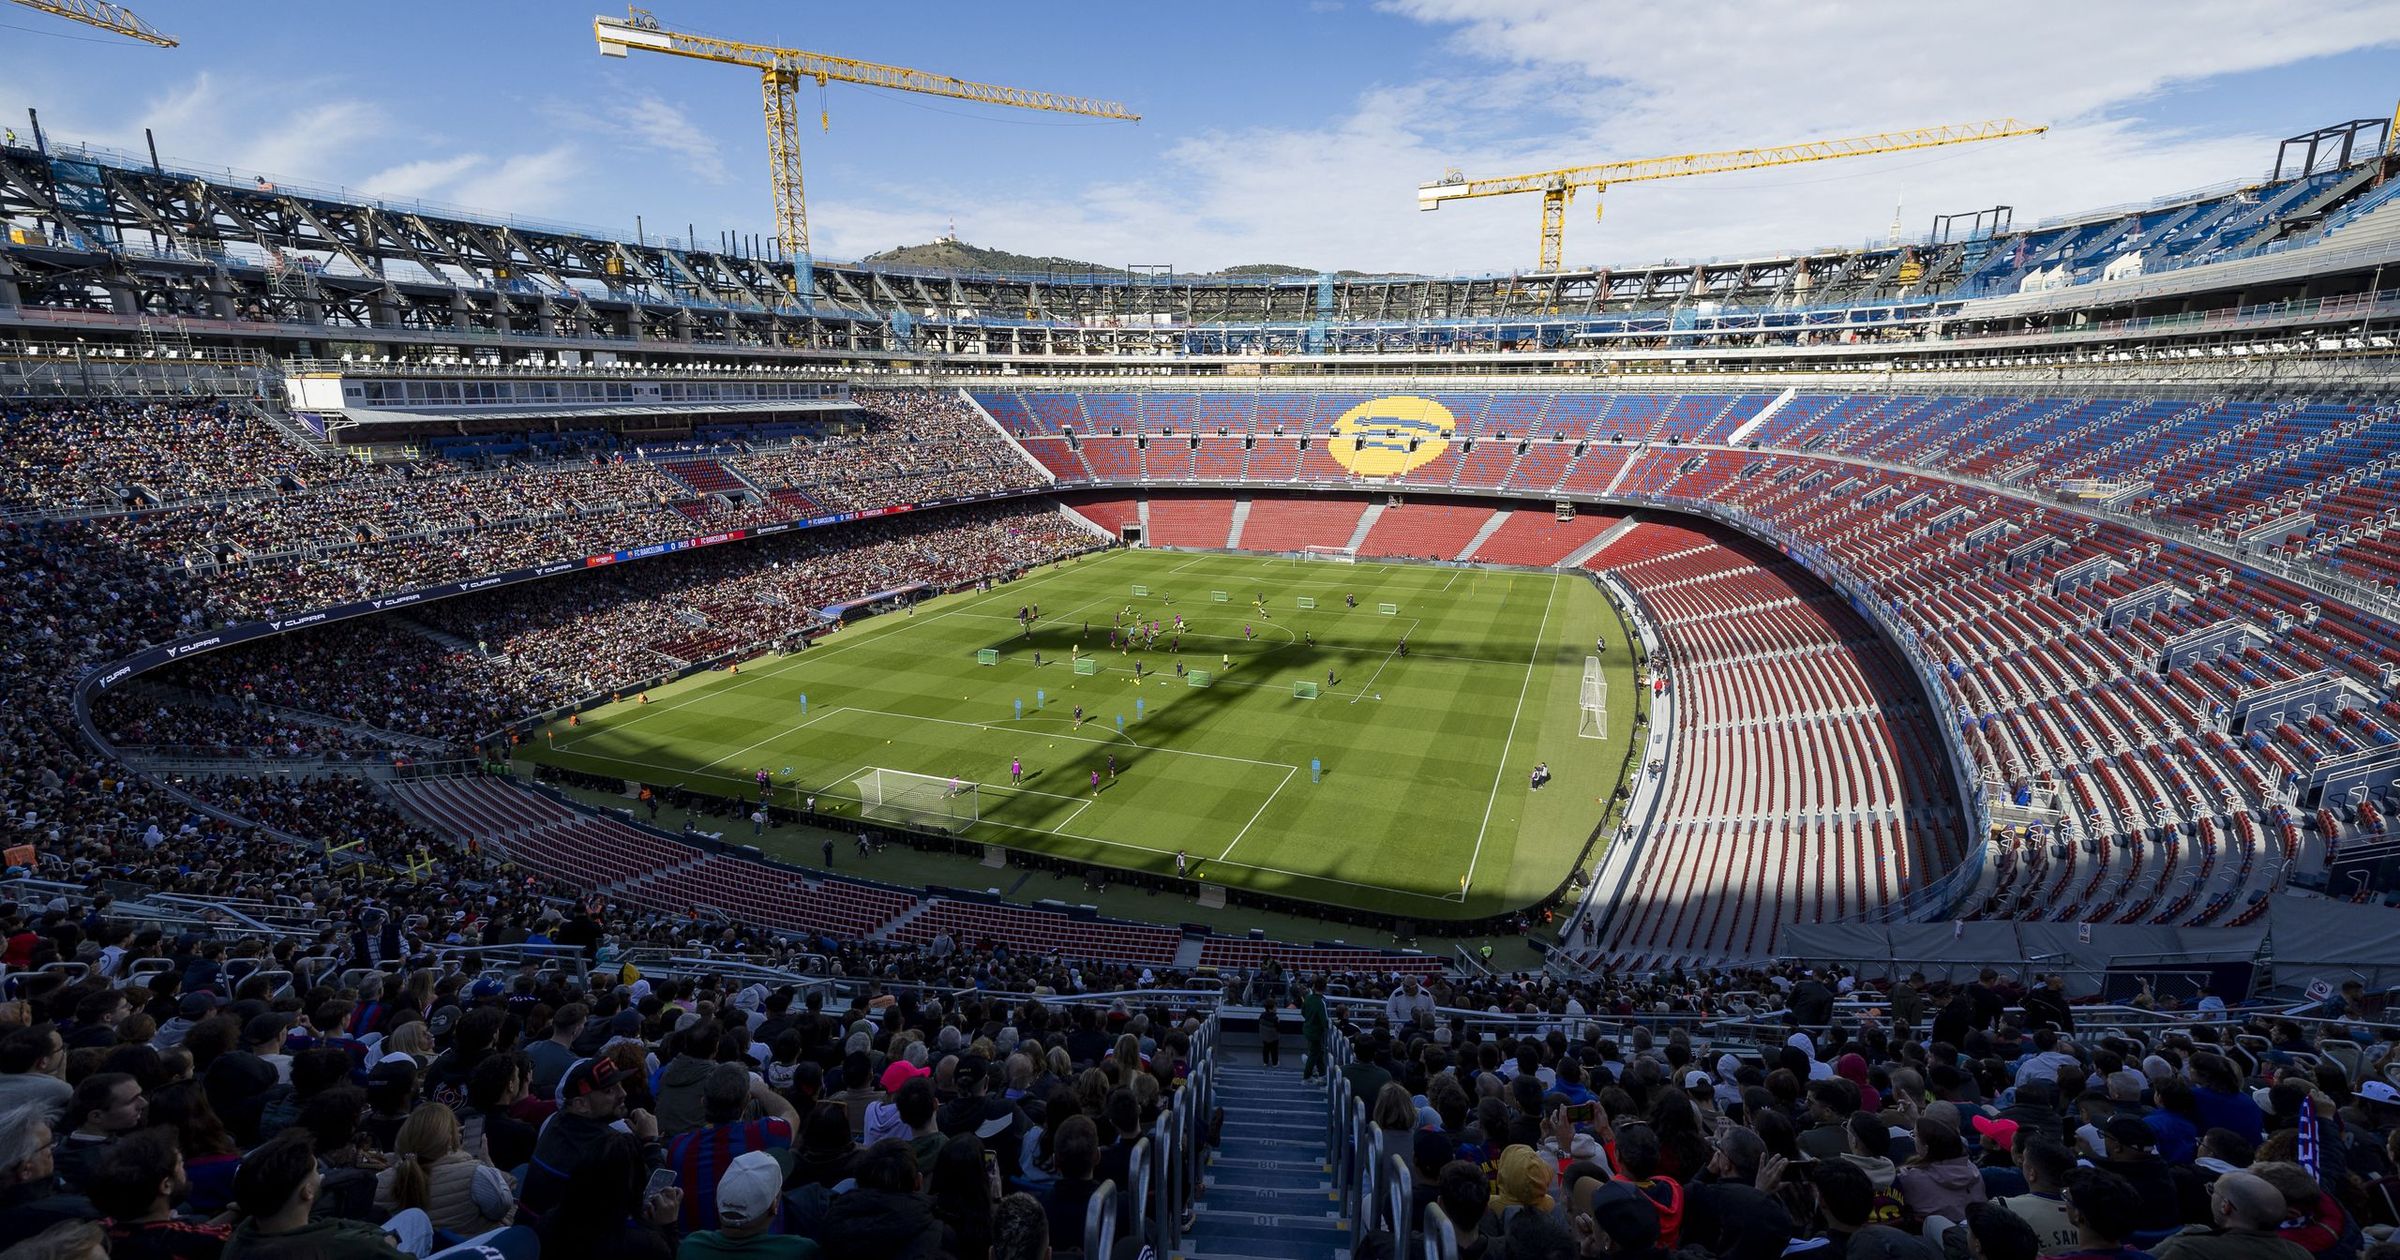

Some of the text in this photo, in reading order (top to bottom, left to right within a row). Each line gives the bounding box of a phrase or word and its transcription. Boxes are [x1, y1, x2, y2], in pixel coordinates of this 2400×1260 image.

[640, 546, 664, 556] BARCELONA
[545, 564, 572, 572] CUPRA
[470, 578, 500, 588] CUPRA
[385, 594, 420, 606] CUPRA
[285, 614, 326, 626] CUPRA
[180, 637, 220, 653] CUPRA
[106, 666, 130, 683] CUPRA
